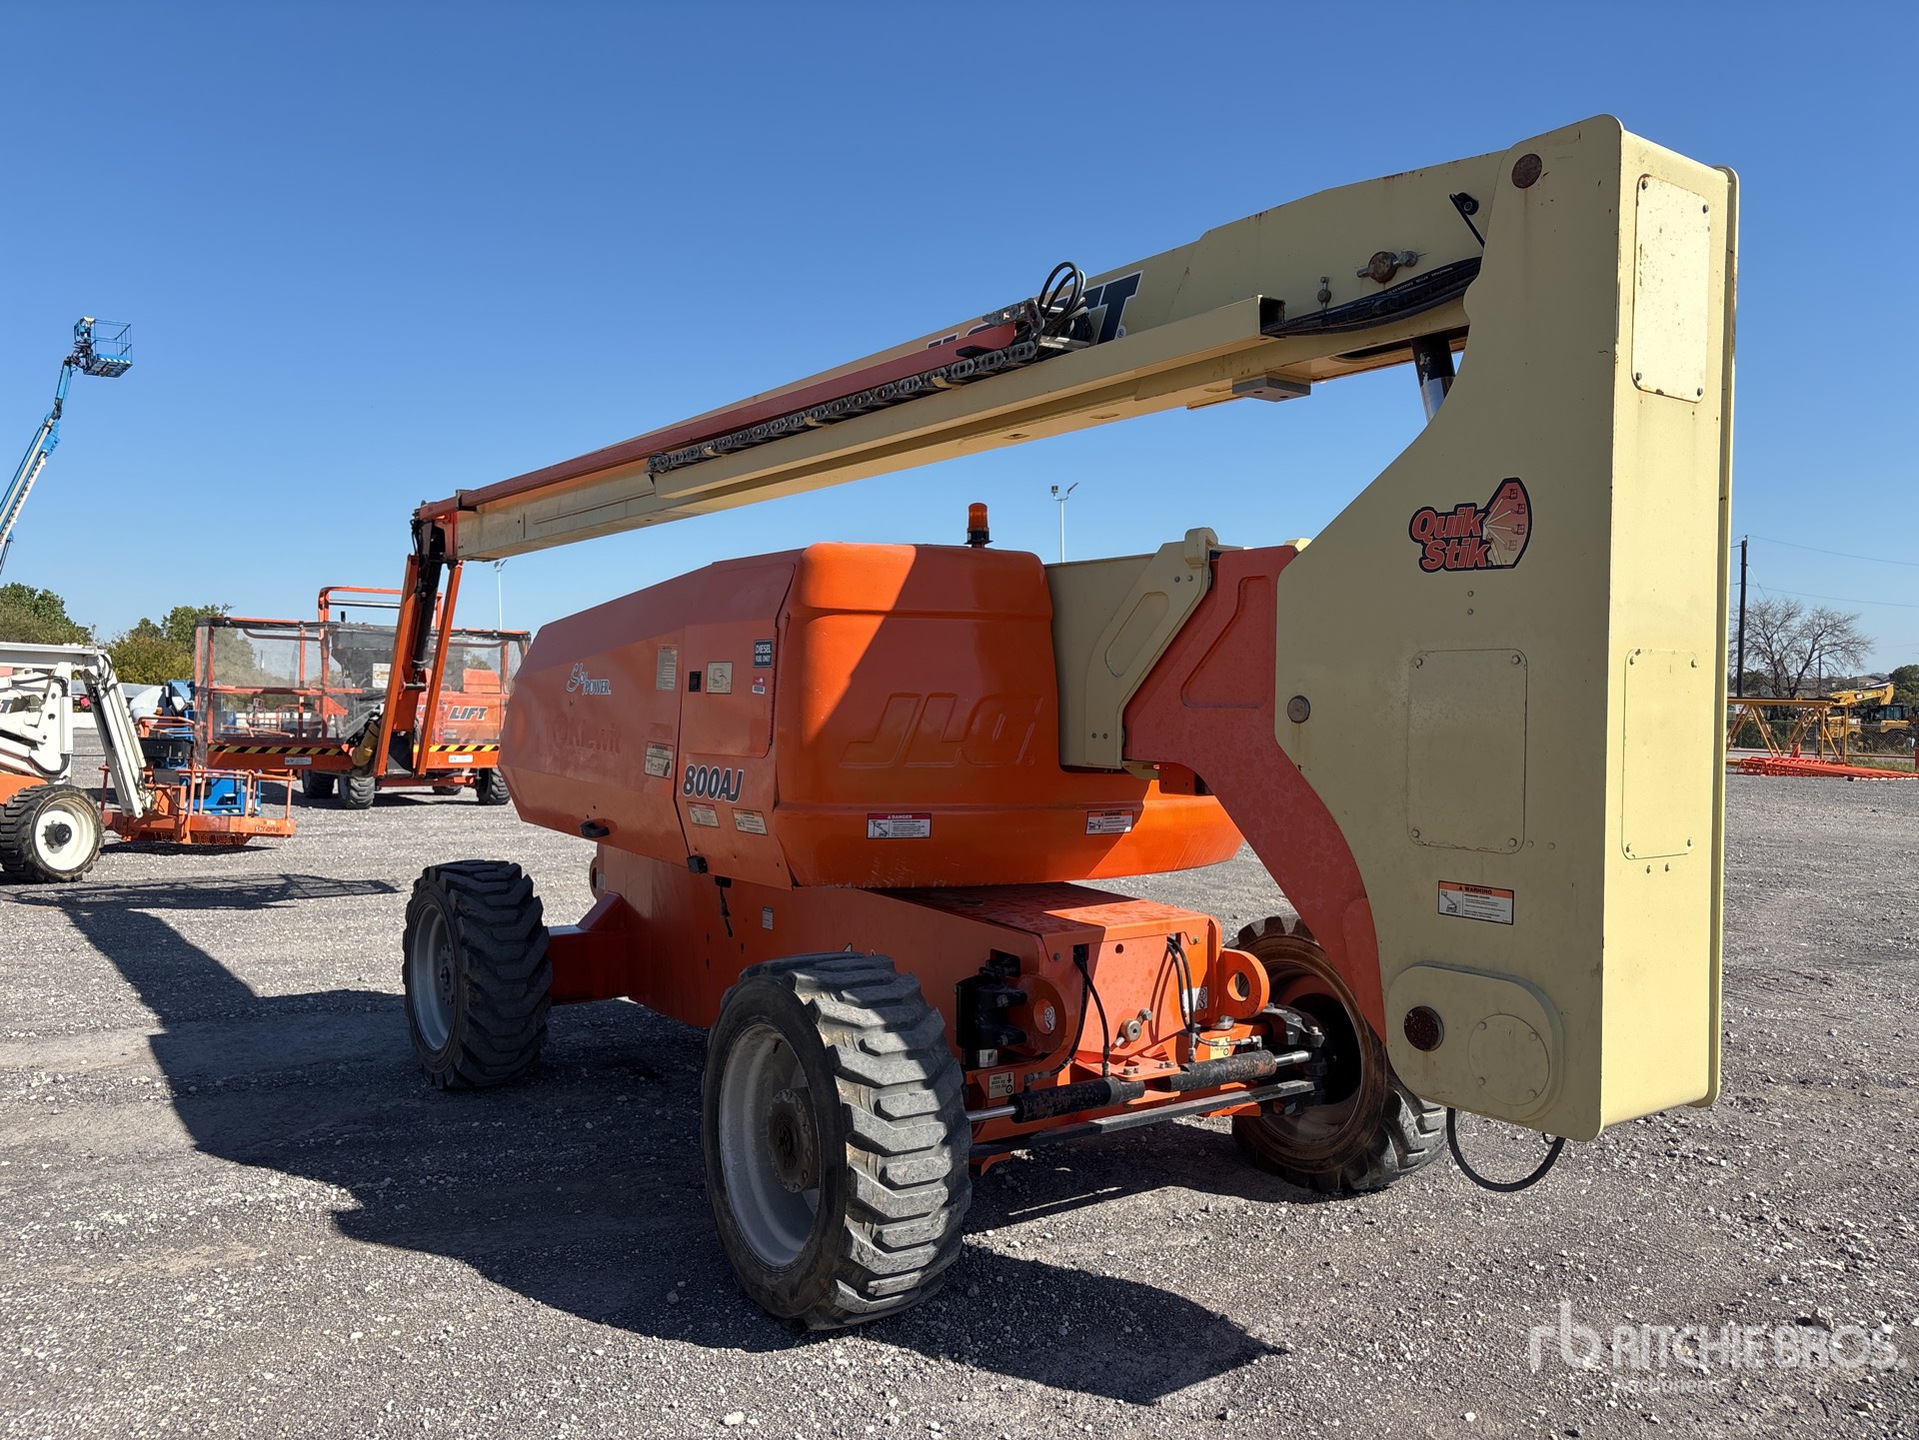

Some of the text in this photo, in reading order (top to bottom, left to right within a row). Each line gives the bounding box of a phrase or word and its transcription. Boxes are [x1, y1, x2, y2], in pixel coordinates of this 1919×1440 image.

[1411, 506, 1486, 543] Quik
[1421, 537, 1491, 570] Stik
[583, 679, 612, 696] POWER
[449, 706, 488, 721] LIFT
[838, 692, 1044, 768] JLG
[682, 763, 745, 804] 800AJ
[1464, 886, 1493, 895] WARNING
